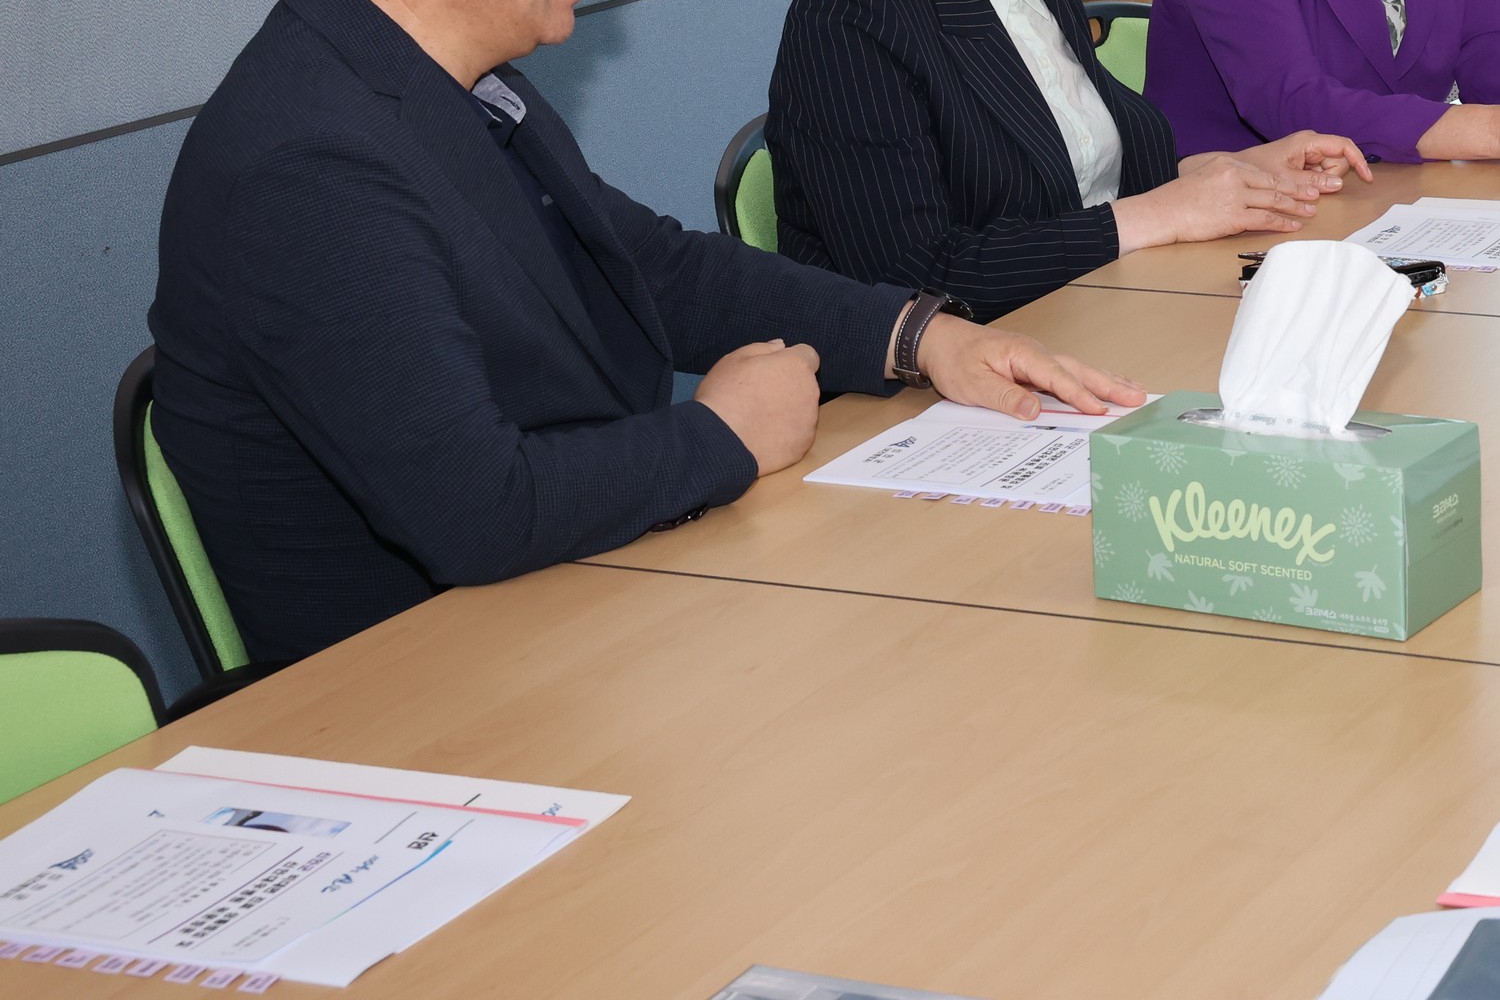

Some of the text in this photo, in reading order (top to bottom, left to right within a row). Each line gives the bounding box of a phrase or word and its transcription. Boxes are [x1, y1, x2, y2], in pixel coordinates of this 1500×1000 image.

[1149, 481, 1336, 566] Kleenex
[1174, 552, 1312, 581] NATURAL SOFT SCENTED
